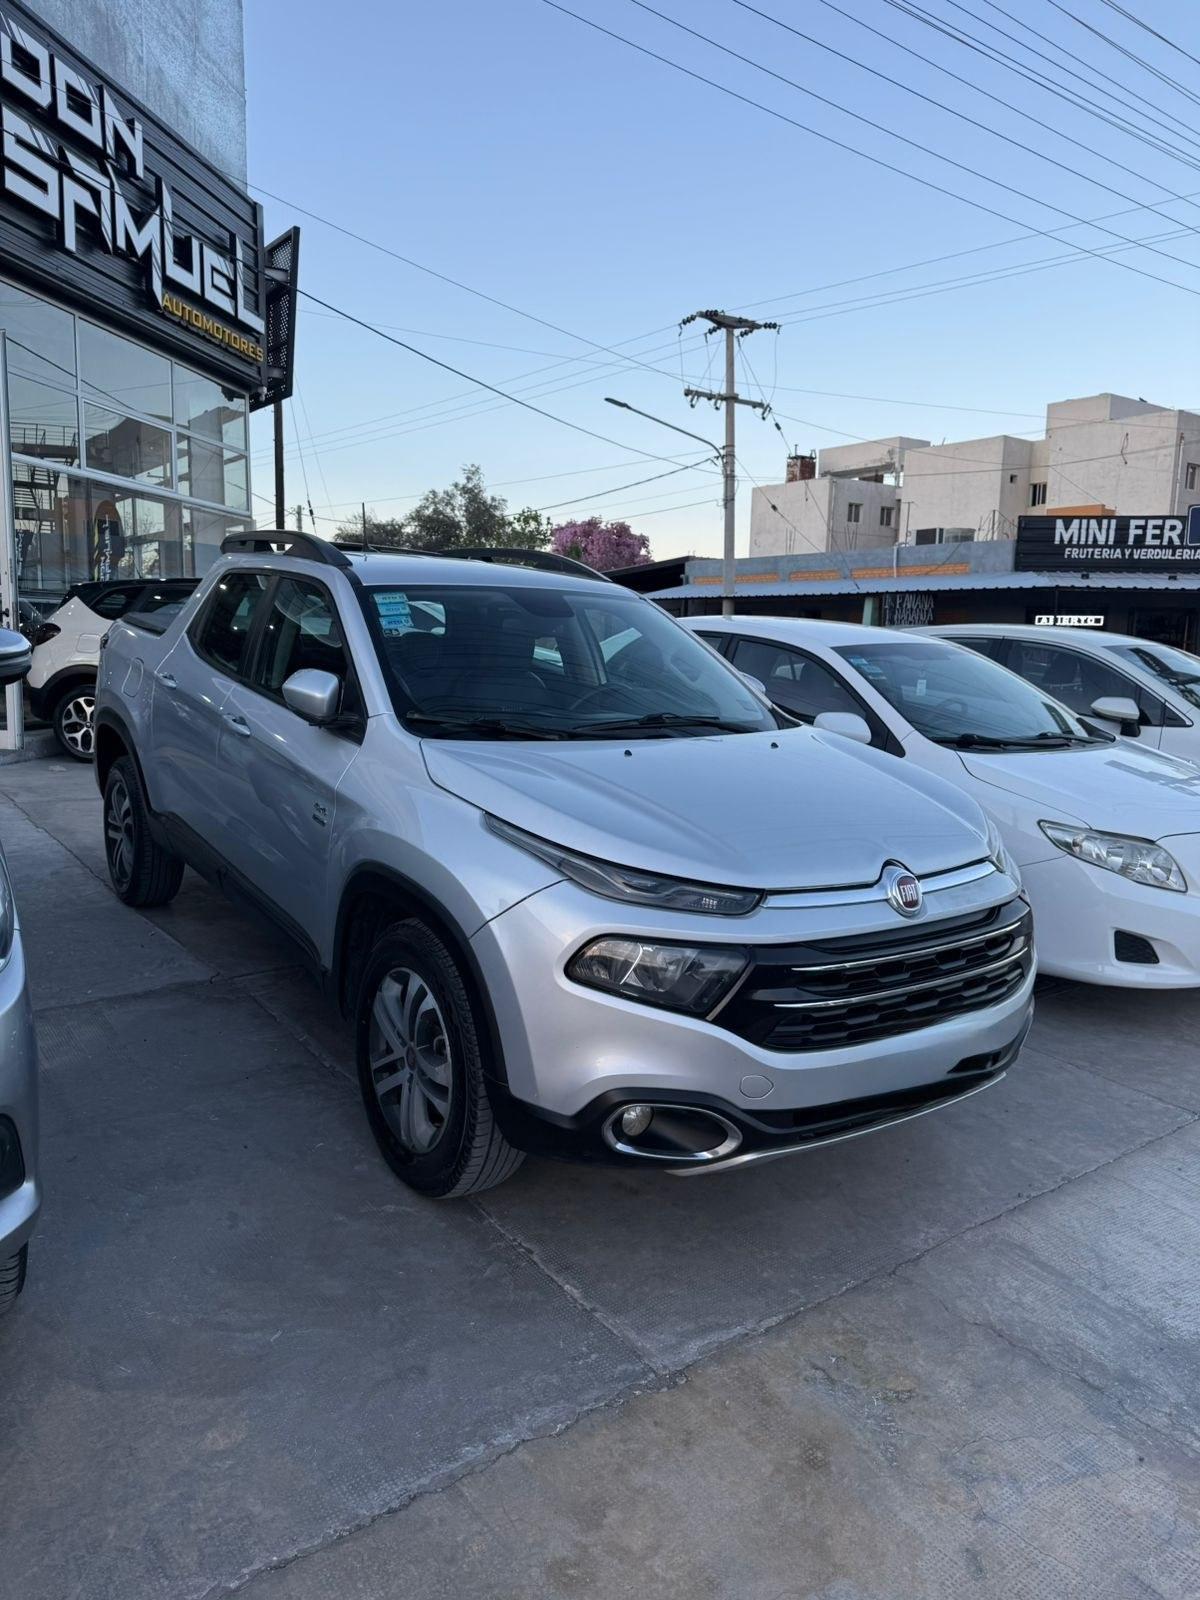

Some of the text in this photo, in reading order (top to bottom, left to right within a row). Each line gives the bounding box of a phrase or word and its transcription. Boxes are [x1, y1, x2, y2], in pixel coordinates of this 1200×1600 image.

[0, 10, 143, 181] DON
[3, 103, 265, 335] SAMUEL
[162, 293, 264, 362] AUTOMOTORES
[1054, 518, 1188, 546] MINI FER
[1064, 547, 1200, 560] FRUTERIA Y VERDULERIA
[900, 883, 918, 902] FIAT
